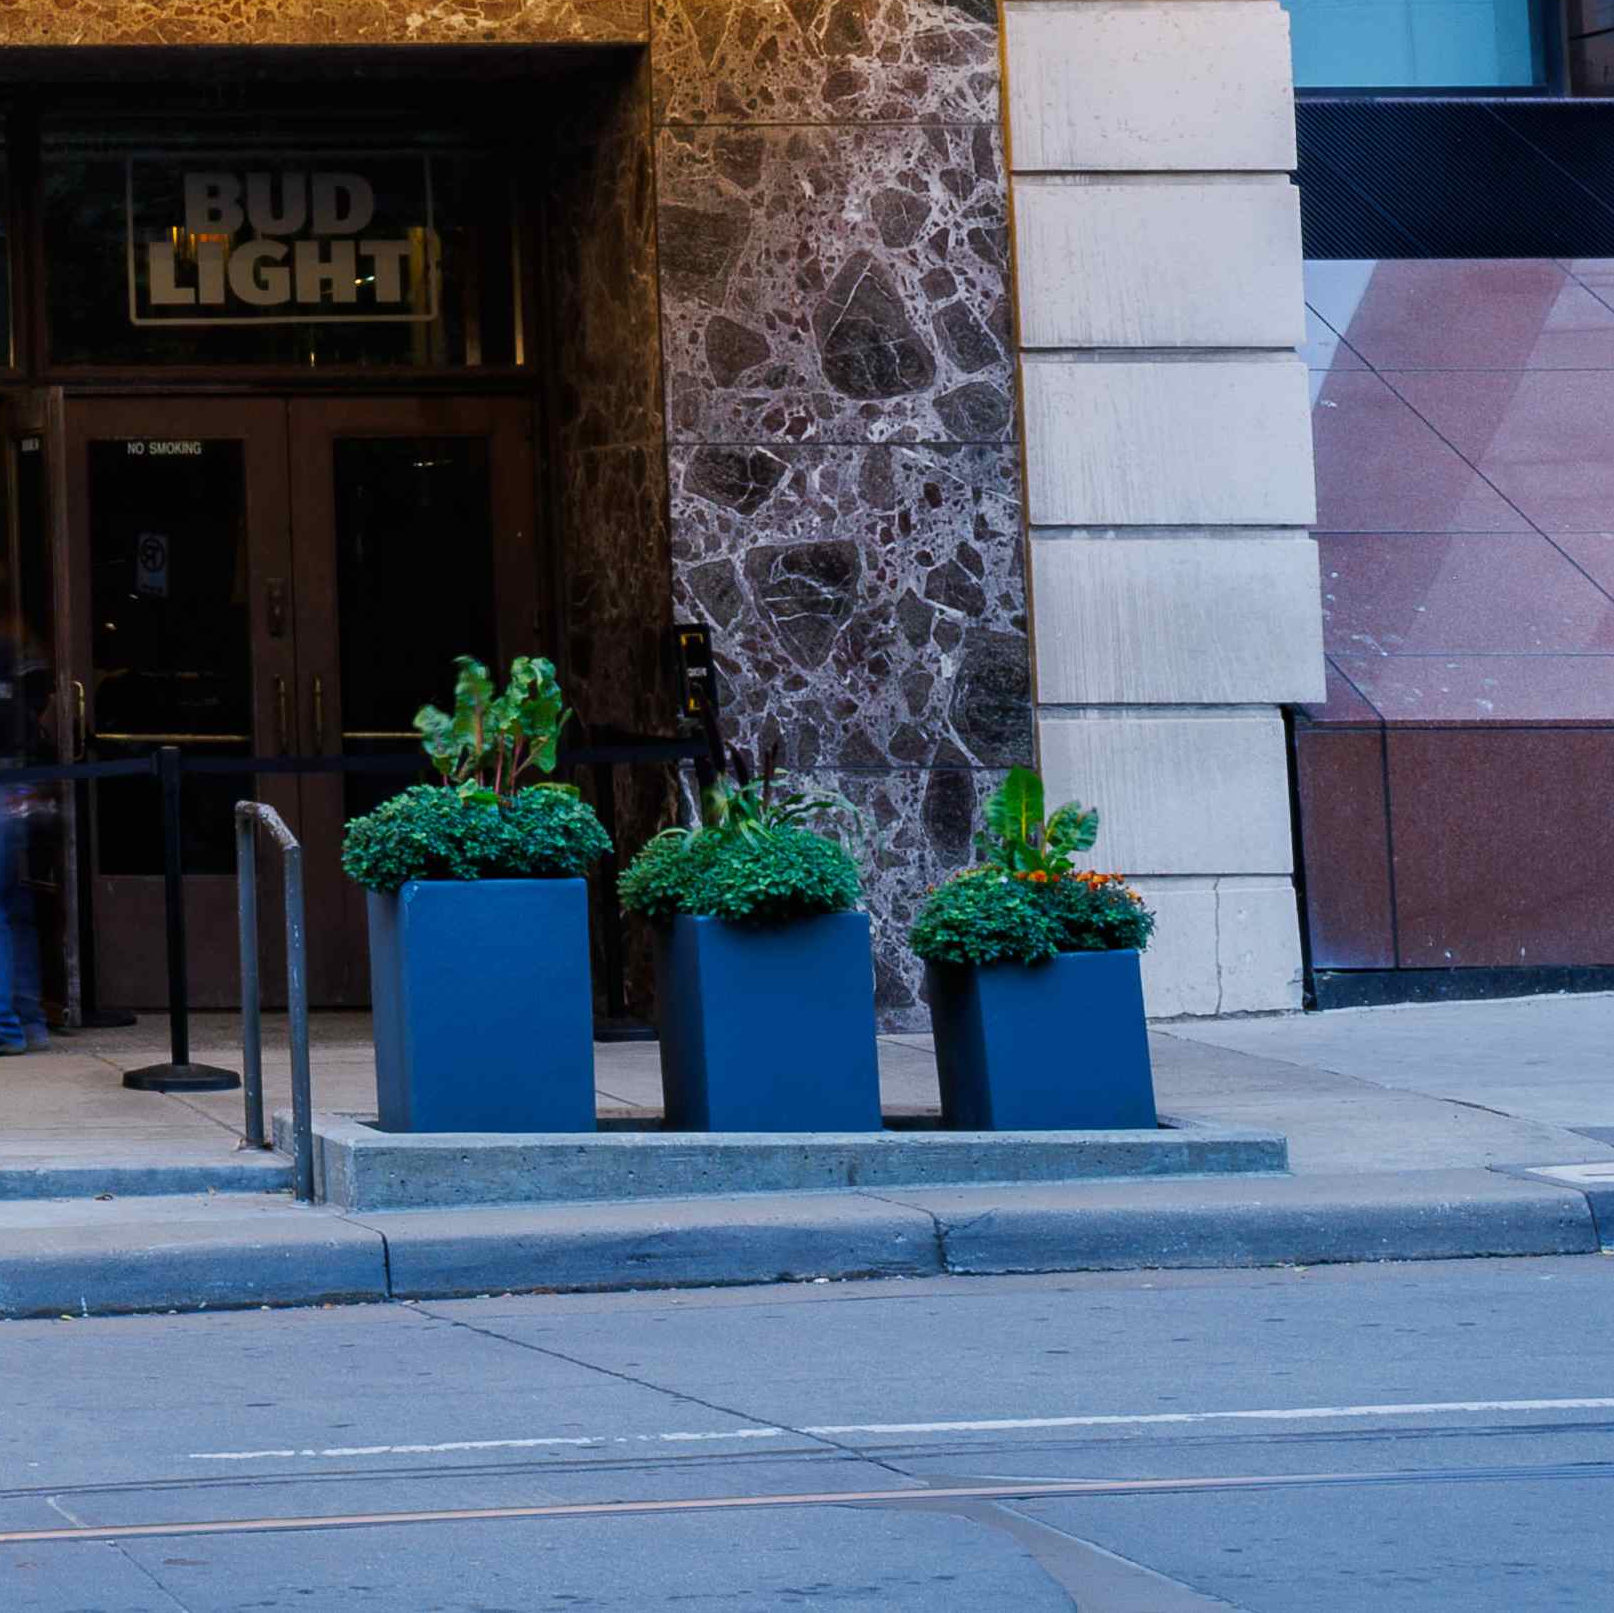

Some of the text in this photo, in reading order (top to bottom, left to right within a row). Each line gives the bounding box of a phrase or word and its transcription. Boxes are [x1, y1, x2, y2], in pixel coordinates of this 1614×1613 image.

[184, 171, 374, 236] BUD
[149, 239, 411, 306] LIGHT
[127, 441, 202, 456] NO SMOKING
